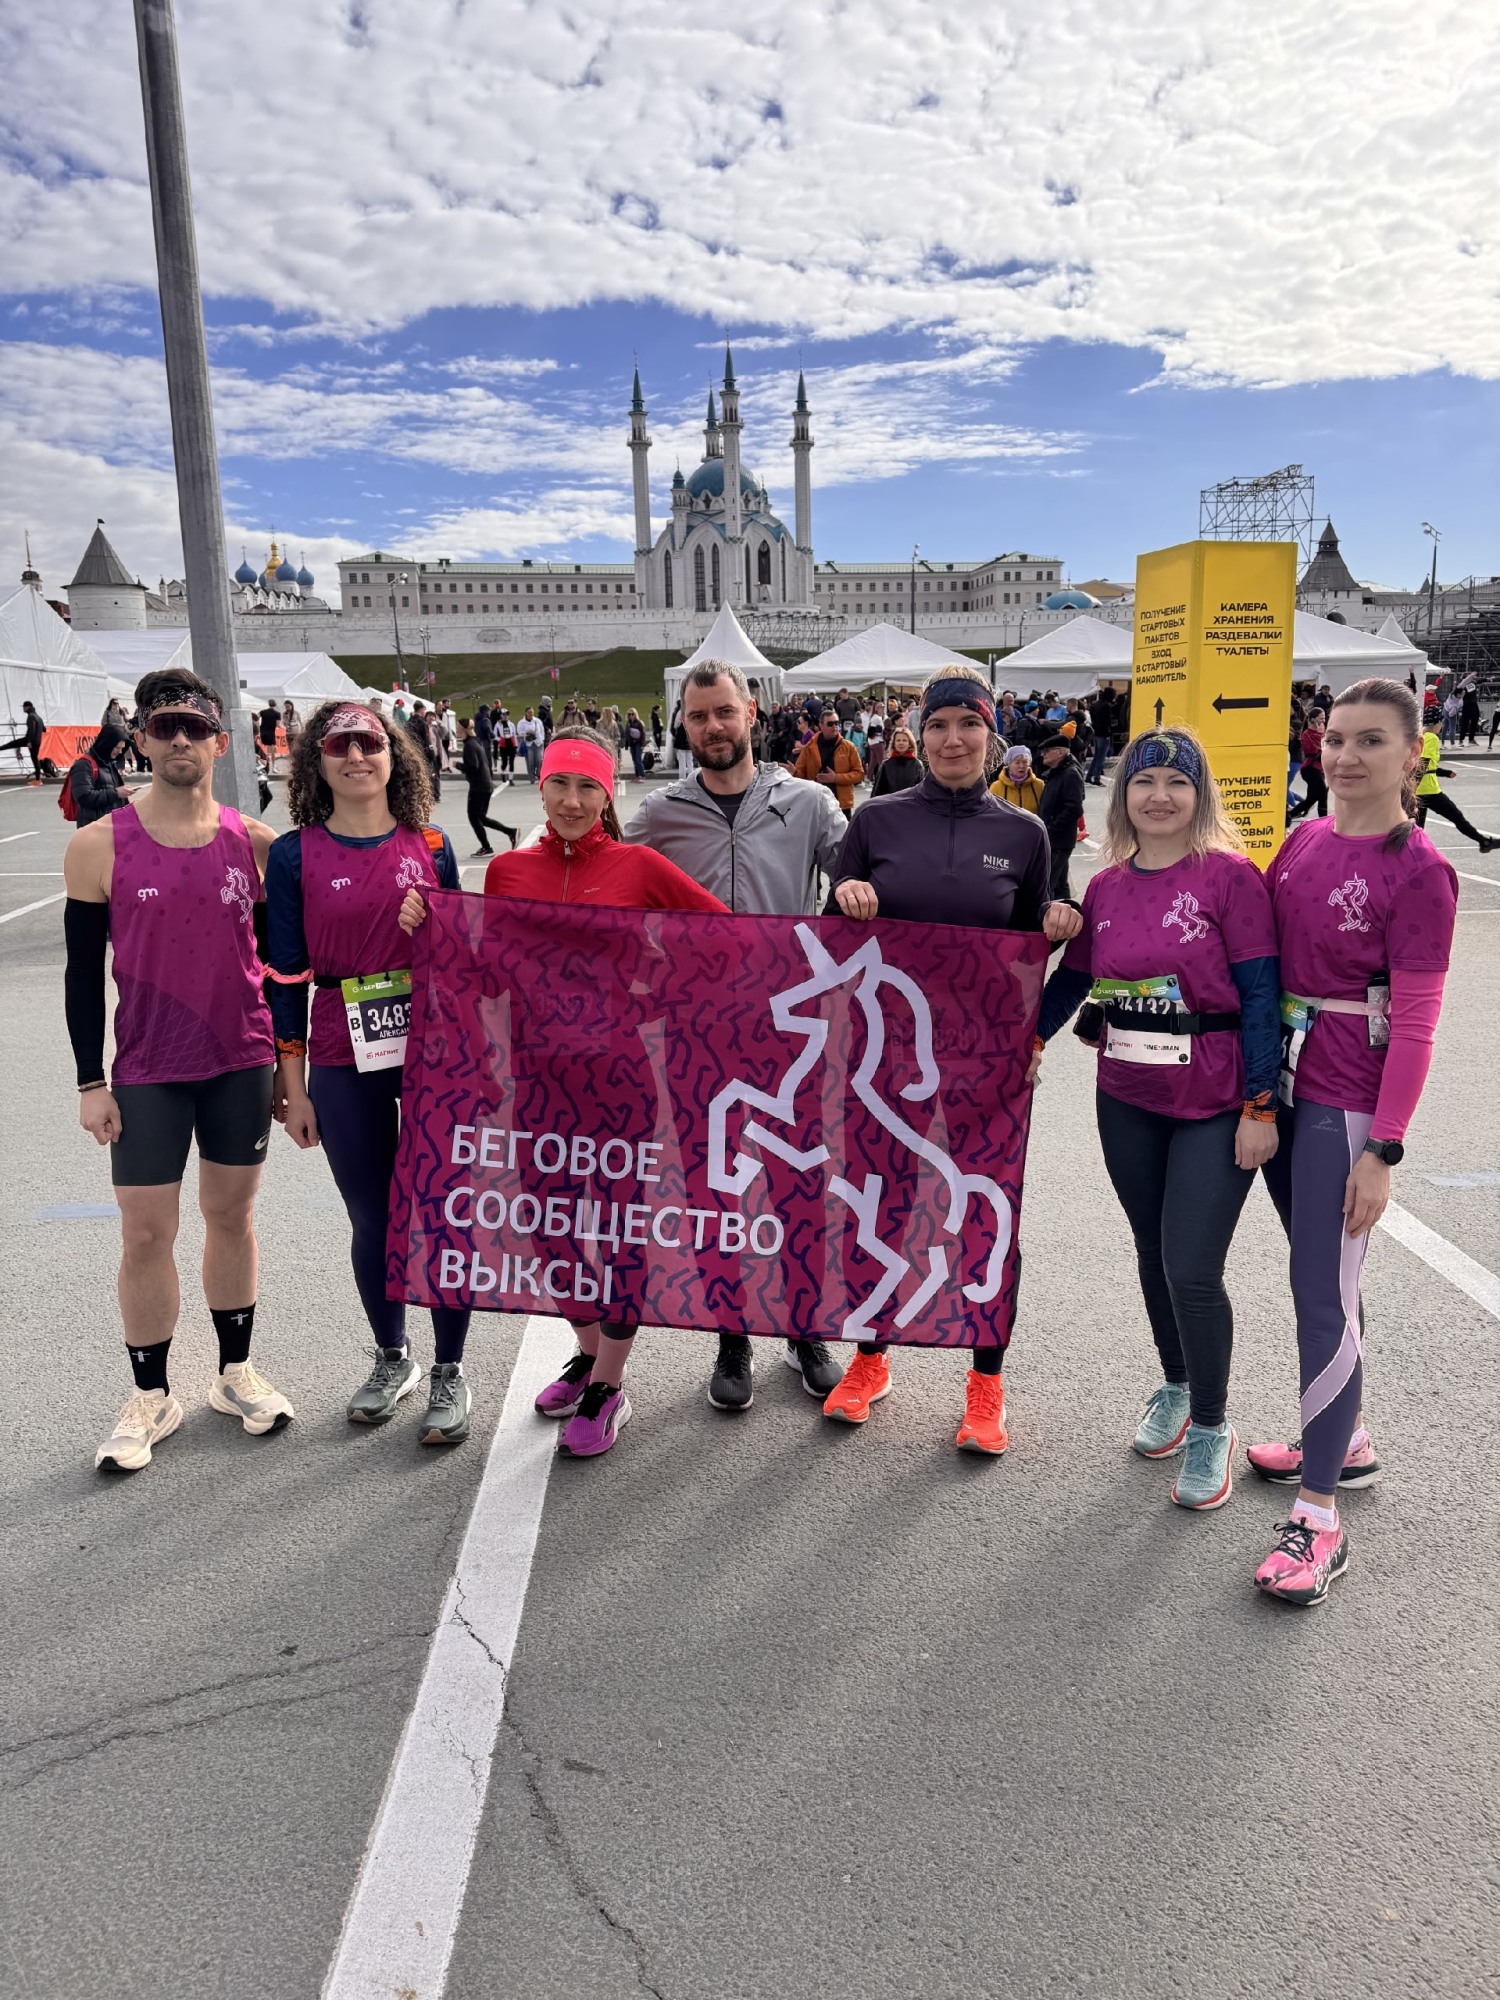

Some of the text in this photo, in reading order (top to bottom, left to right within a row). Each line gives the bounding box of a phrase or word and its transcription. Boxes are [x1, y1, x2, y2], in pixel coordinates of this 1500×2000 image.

[1140, 604, 1187, 620] ПОЛУЧЕНИЕ
[1220, 602, 1268, 612] КАМЕРА
[1140, 618, 1185, 633] СТАРТОВЫХ
[1213, 615, 1275, 625] ХРАНЕНИЯ
[1144, 631, 1180, 645] ПАКЕТОВ
[1205, 631, 1283, 642] РАЗДЕВАЛКИ
[1151, 648, 1172, 659] ВХОД
[1215, 646, 1270, 656] ТУАЛЕТЫ
[1136, 657, 1187, 673] В СТАРТОВЫЙ
[1136, 672, 1187, 685] НАКОПИТЕЛЬ
[1213, 776, 1272, 787] ЛУЧЕНИЕ
[1222, 788, 1270, 798] РТОВЫХ
[1223, 801, 1262, 811] КЕТОВ
[983, 854, 1010, 869] NIKE
[450, 1124, 664, 1182] БЕГОВОЕ
[443, 1186, 785, 1256] СООБЩЕСТВО
[438, 1248, 613, 1305] ВЫКСЫ
